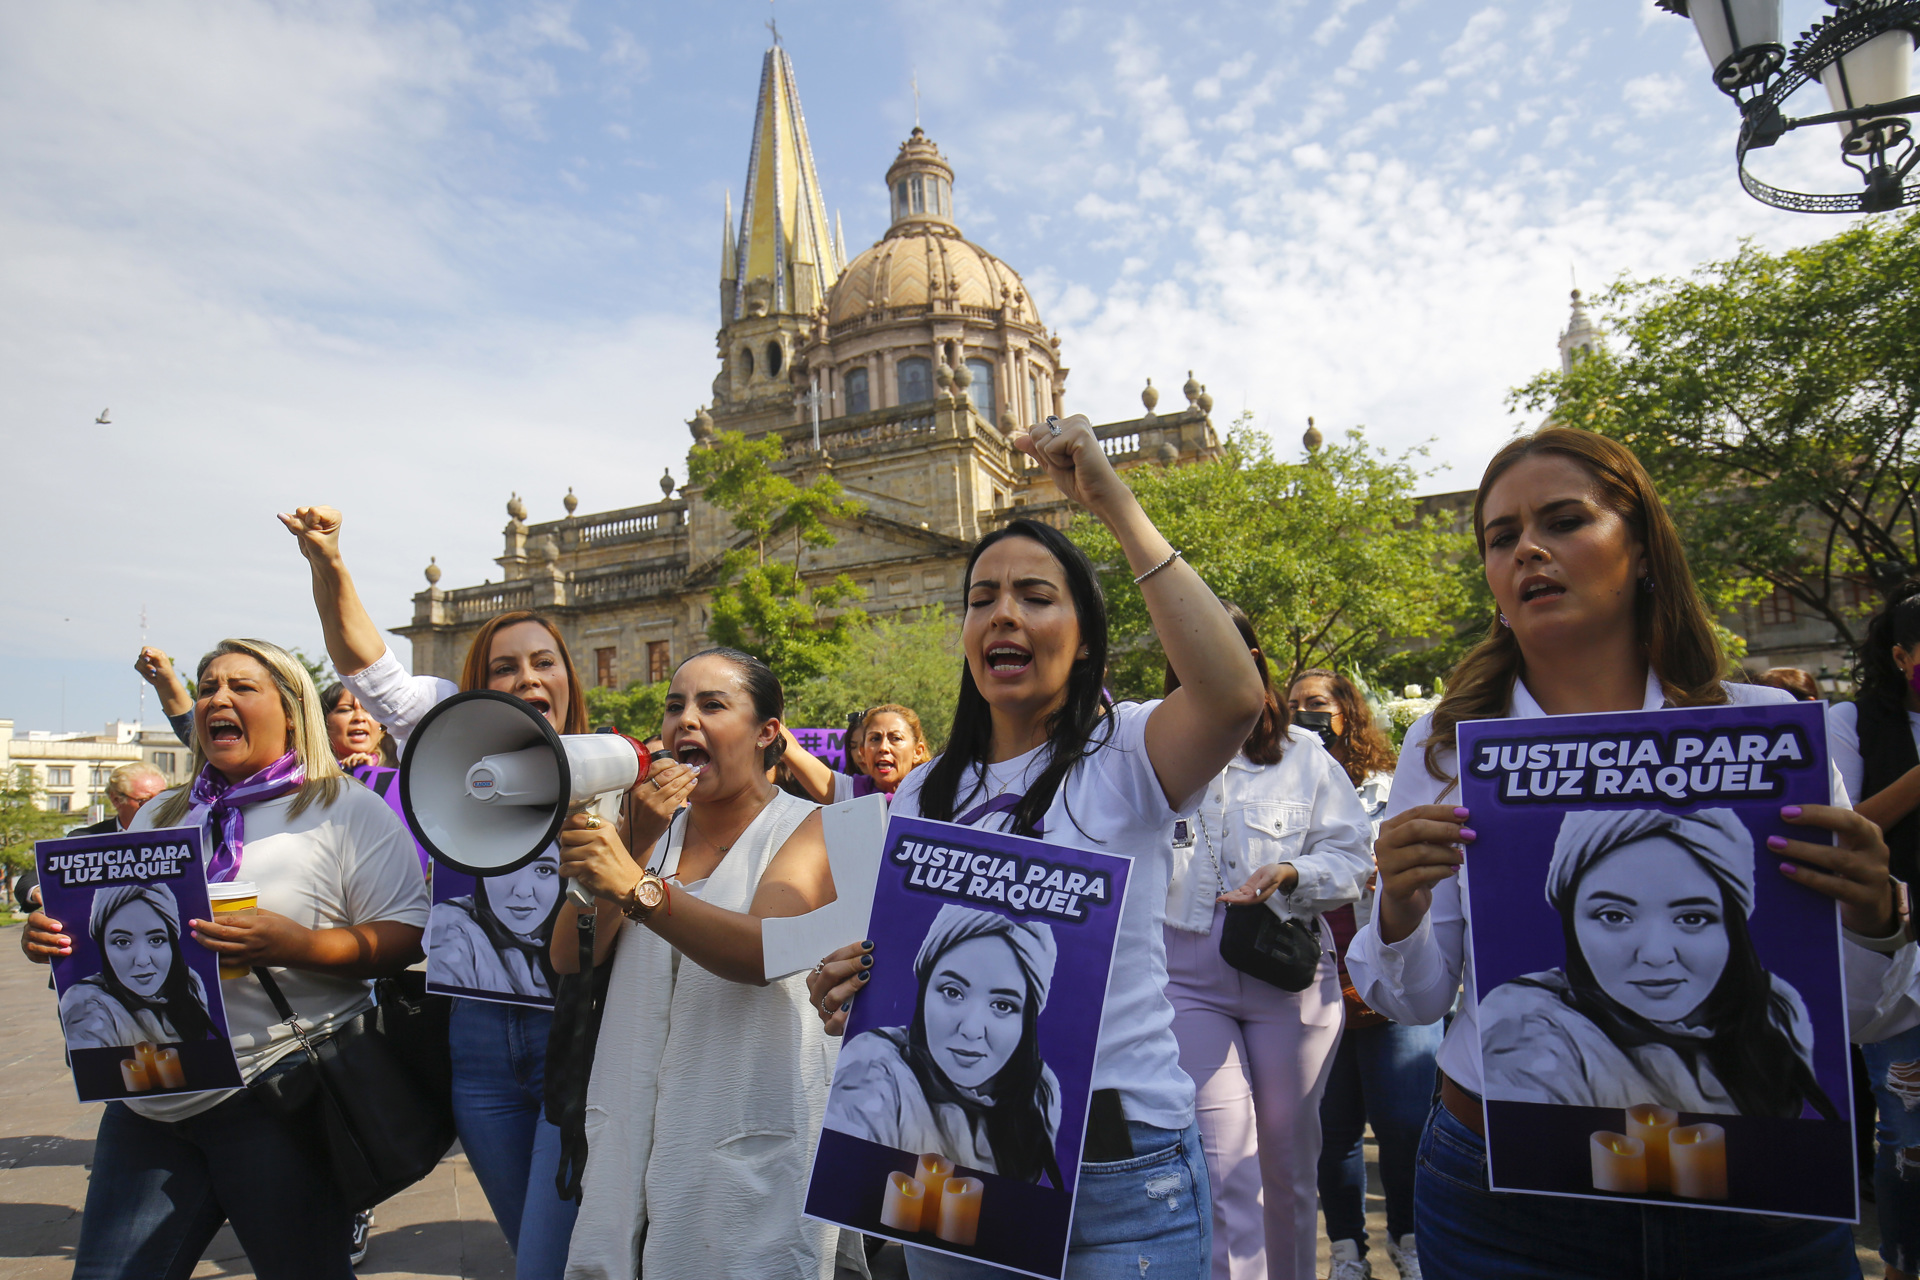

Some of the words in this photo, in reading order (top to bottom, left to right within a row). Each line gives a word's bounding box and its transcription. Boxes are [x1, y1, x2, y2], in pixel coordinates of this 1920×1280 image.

[798, 732, 847, 751] #M
[1476, 739, 1662, 772] JUSTICIA
[1674, 733, 1803, 765] PARA
[1506, 769, 1584, 797] LUZ
[1594, 763, 1774, 799] RAQUEL
[48, 849, 137, 872] JUSTICIA
[140, 844, 192, 862] PARA
[64, 866, 103, 885] LUZ
[107, 859, 182, 880] RAQUEL
[895, 840, 1017, 882] JUSTICIA
[1023, 864, 1106, 899] PARA
[909, 864, 965, 893] LUZ
[966, 875, 1083, 917] RAQUEL
